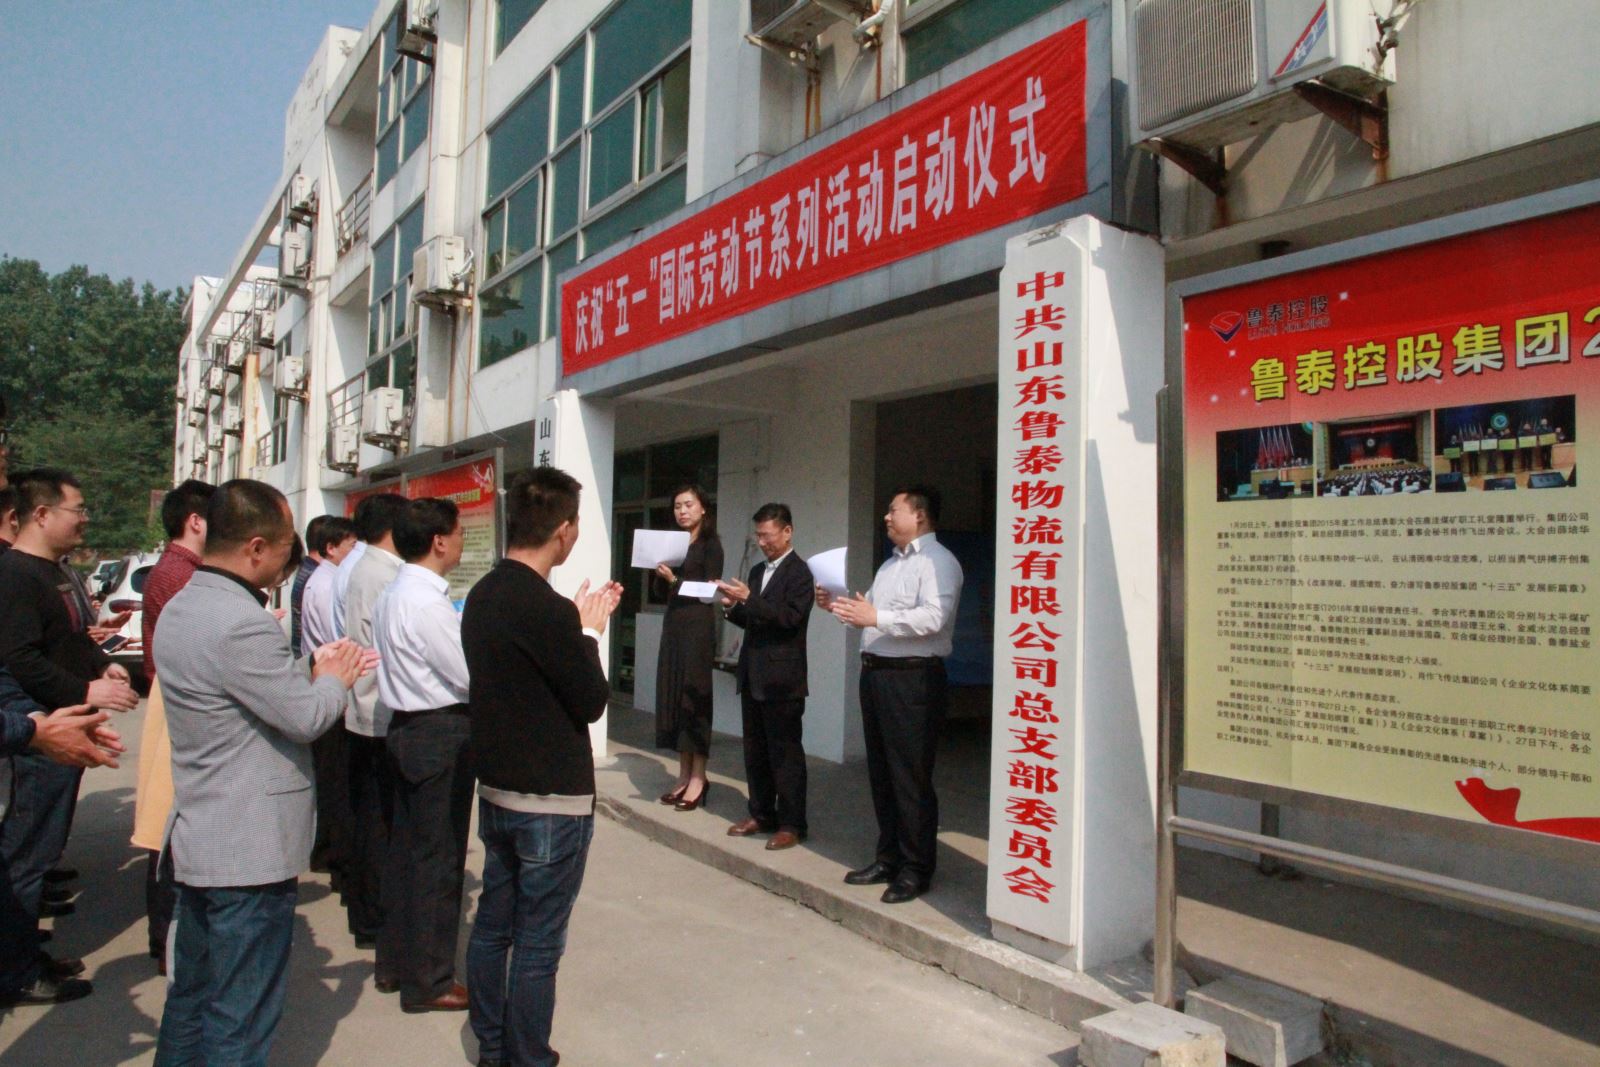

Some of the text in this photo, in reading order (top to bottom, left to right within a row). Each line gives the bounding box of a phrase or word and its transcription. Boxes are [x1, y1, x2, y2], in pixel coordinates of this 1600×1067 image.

[575, 77, 1047, 354] 庆祝“五一”国际劳动节系列活动启动仪式
[1003, 271, 1066, 903] 中共山东鲁泰物流有限公司总支部委员会
